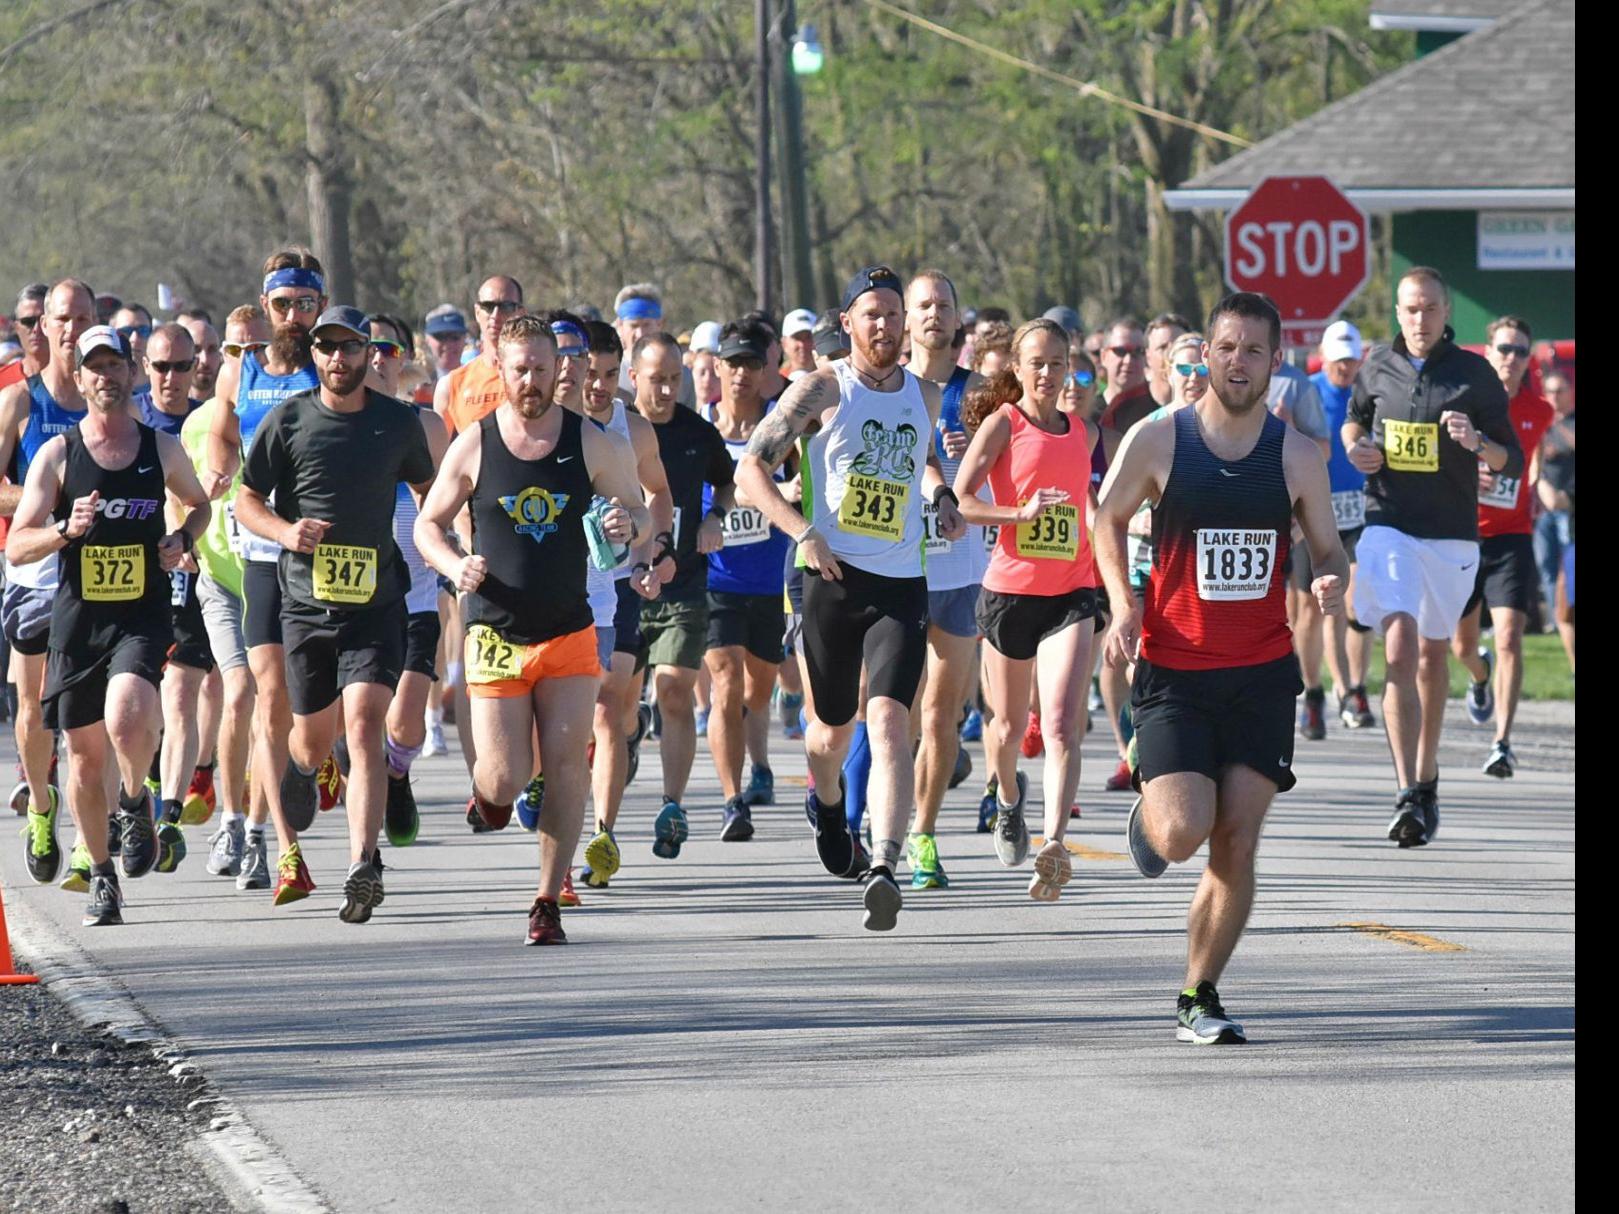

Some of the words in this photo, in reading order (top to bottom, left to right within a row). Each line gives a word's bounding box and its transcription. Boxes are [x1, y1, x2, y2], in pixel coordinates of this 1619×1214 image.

[1236, 220, 1360, 278] STOP
[1393, 434, 1427, 458] 346
[849, 476, 880, 493] LAKE
[883, 482, 905, 497] RUN
[851, 490, 895, 523] 343
[1055, 505, 1075, 518] RUN
[843, 517, 899, 536] www.lakerunclub.org
[1028, 516, 1069, 544] 339
[1203, 532, 1240, 545] LAKE
[1244, 532, 1271, 545] RUN
[85, 548, 116, 560] LAKE
[118, 547, 140, 558] RUN
[318, 546, 349, 559] LAKE
[352, 549, 373, 561] RUN
[1204, 547, 1269, 580] 1833
[93, 560, 134, 586] 372
[325, 558, 367, 587] 347
[1202, 582, 1267, 592] www.lakerunclub.org
